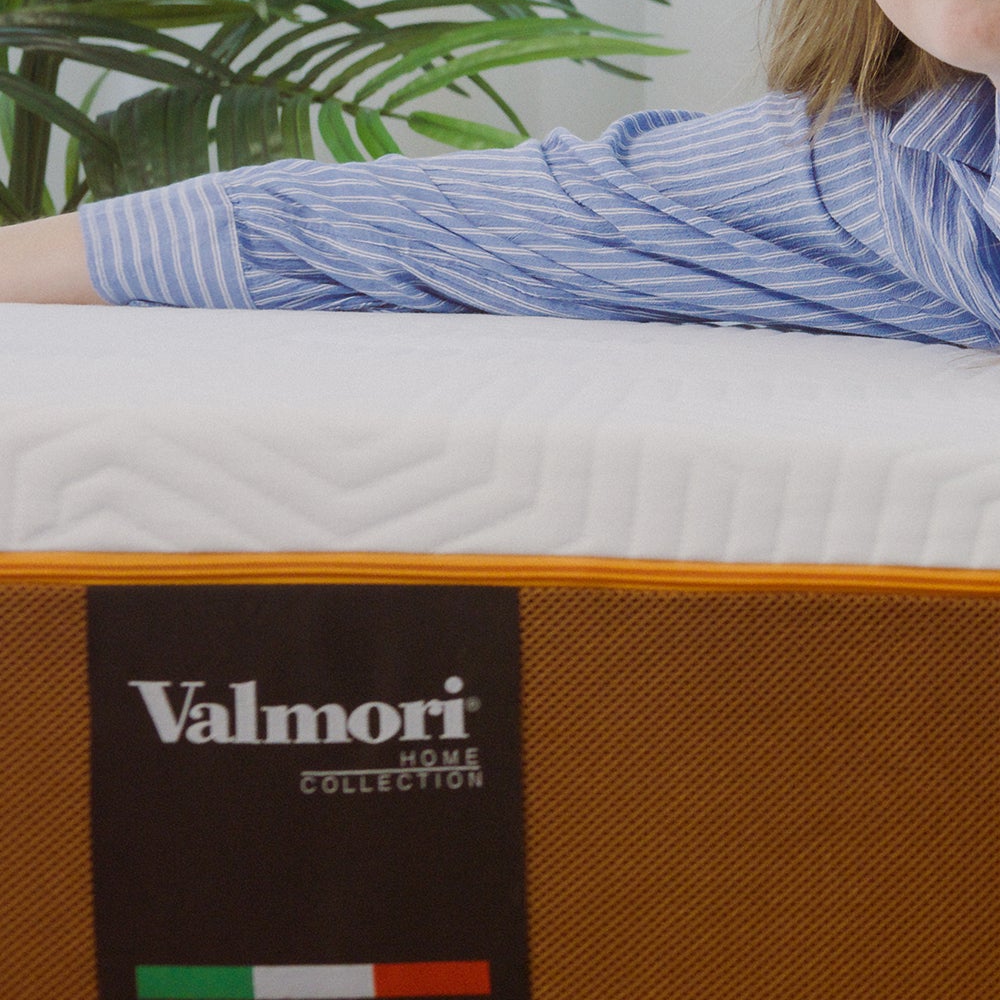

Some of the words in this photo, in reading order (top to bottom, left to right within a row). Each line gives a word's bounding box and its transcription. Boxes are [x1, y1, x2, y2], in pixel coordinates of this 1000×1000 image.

[128, 676, 470, 745] Valmori
[399, 748, 480, 767] HOME
[300, 771, 484, 794] COLLECTION
